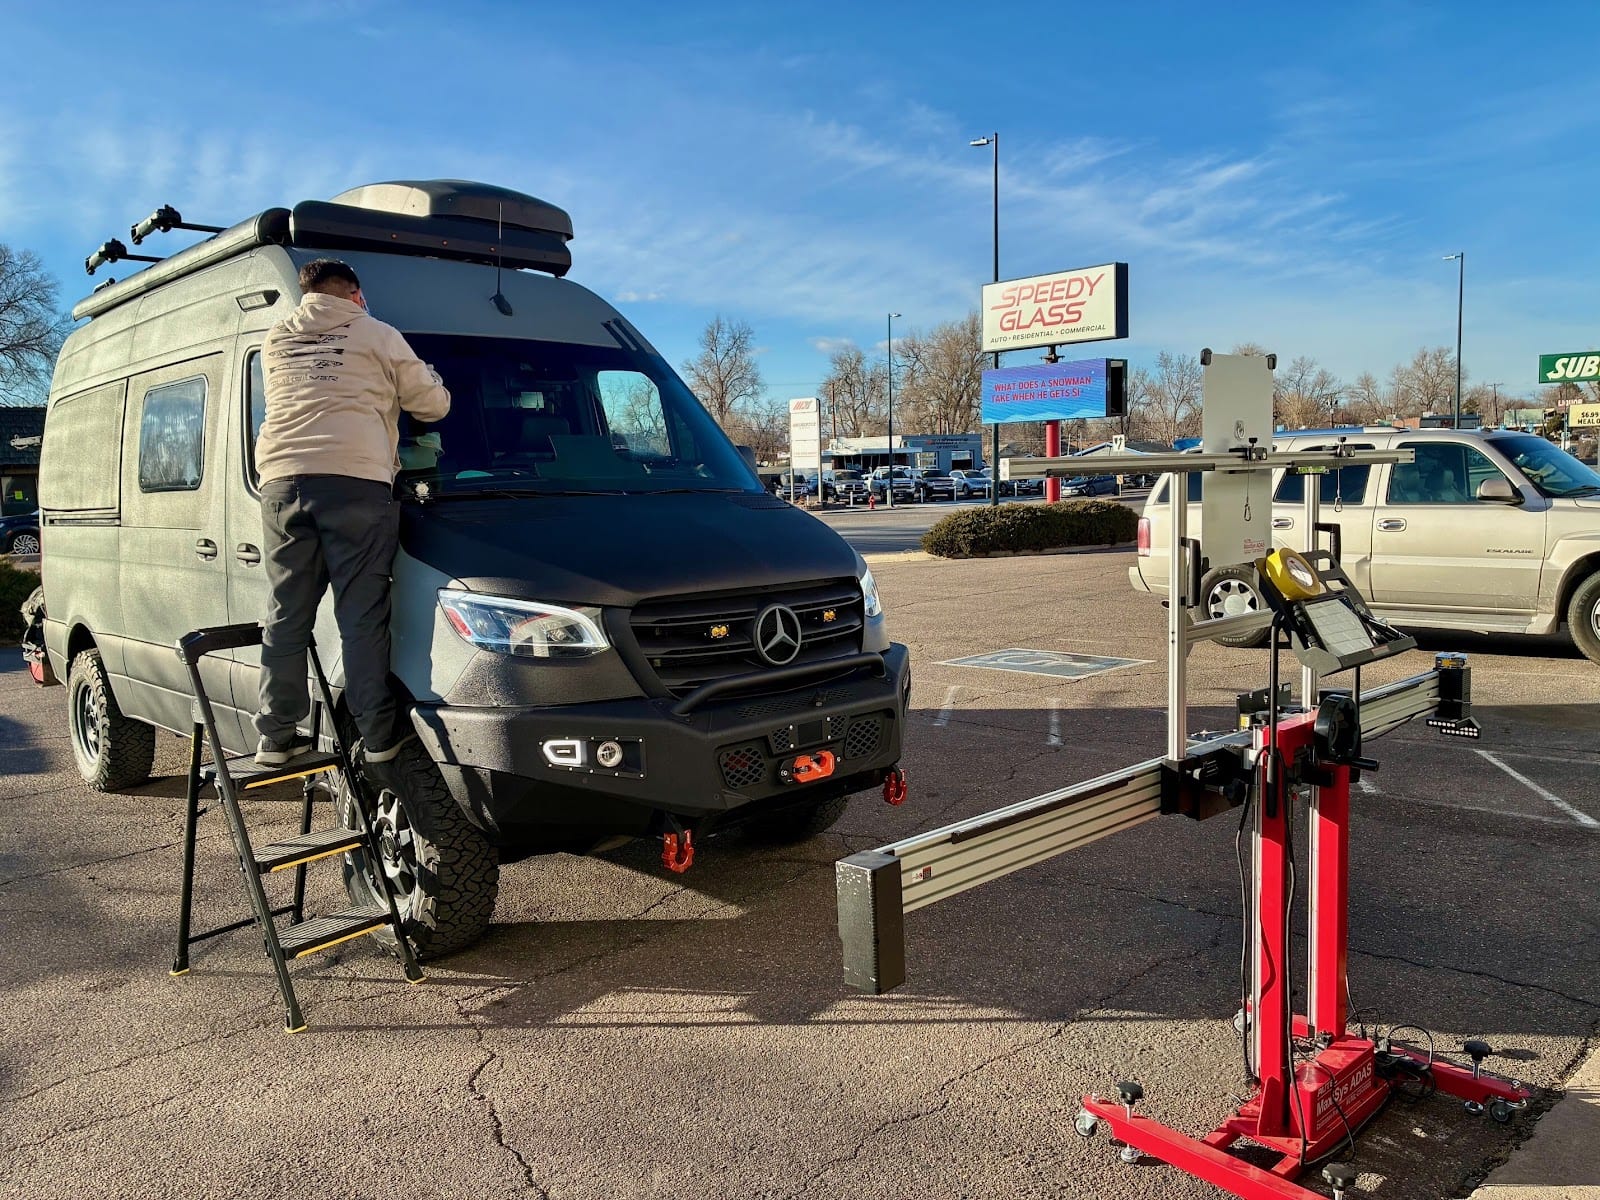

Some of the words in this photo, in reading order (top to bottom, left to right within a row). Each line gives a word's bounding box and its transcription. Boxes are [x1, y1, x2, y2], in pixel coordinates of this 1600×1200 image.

[991, 273, 1105, 310] SPEEDY
[999, 301, 1087, 332] GLASS
[990, 335, 1008, 344] AUTO
[1012, 330, 1054, 341] RESIDENTIAL
[1060, 324, 1106, 335] COMMERCIAL
[1546, 355, 1600, 380] SUB
[992, 393, 1010, 403] TAKE
[1012, 391, 1035, 401] WHEN
[1038, 390, 1047, 399] HE
[1049, 389, 1070, 398] GETS
[994, 382, 1016, 392] WHAT
[1018, 380, 1038, 390] DOES
[1041, 380, 1046, 388] A
[1048, 376, 1092, 387] SNOWMAN
[1350, 1062, 1372, 1091] ADAS
